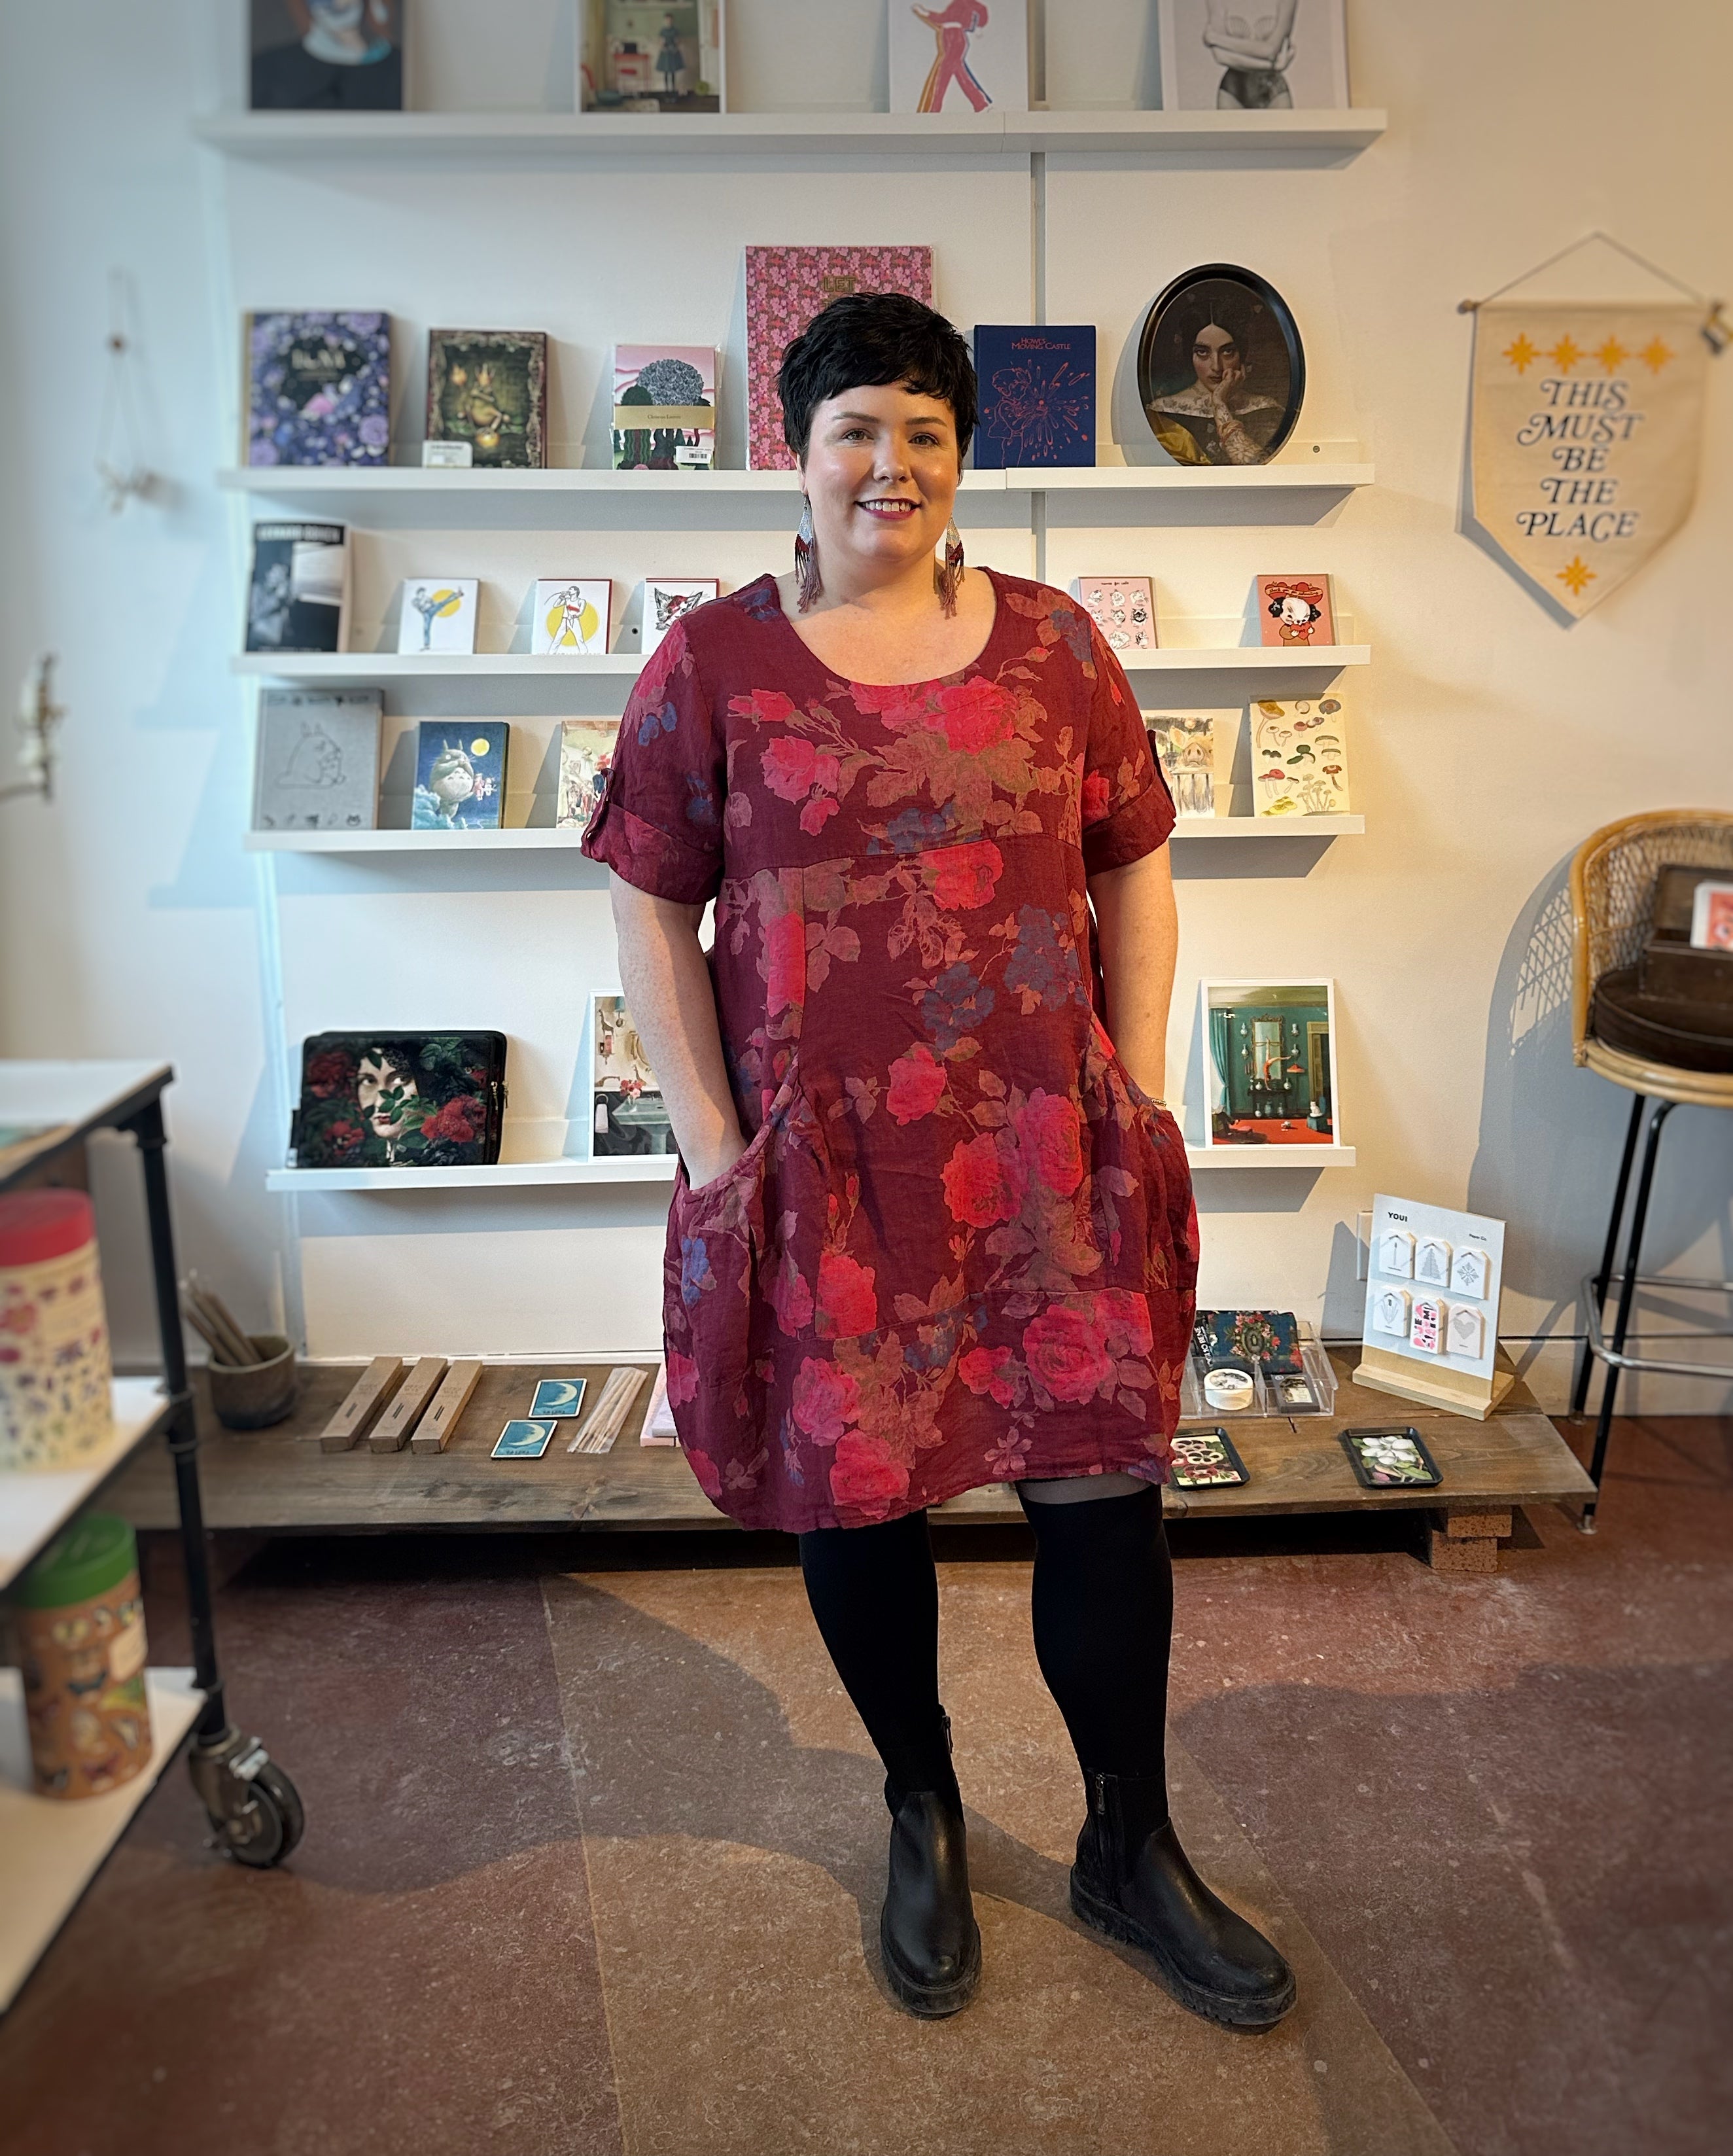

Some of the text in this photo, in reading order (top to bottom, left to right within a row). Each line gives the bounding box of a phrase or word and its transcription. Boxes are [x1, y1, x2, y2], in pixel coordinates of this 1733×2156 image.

[824, 277, 856, 292] LET
[1540, 378, 1629, 412] THIS
[1516, 412, 1645, 446] MUST
[1552, 446, 1609, 472] BE
[1540, 477, 1619, 504] THE
[1516, 511, 1641, 542] PLACE
